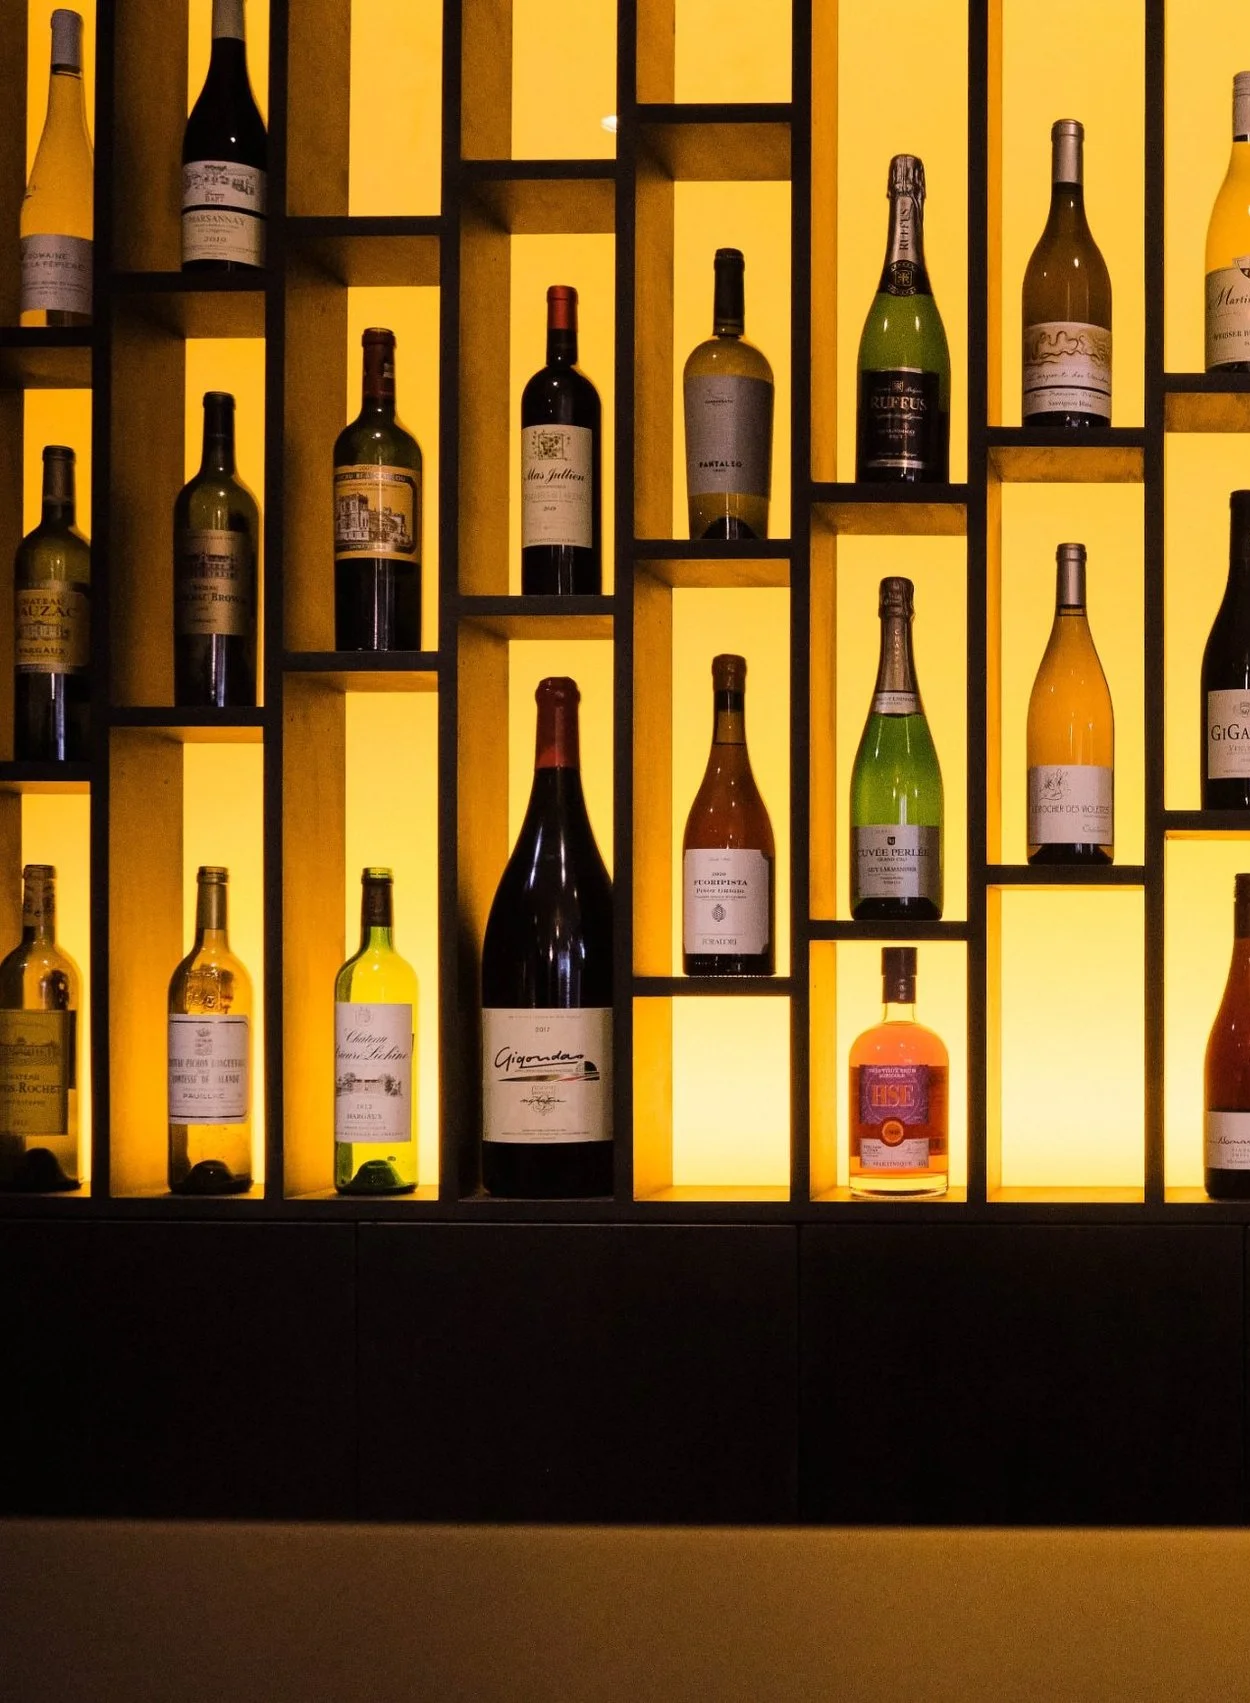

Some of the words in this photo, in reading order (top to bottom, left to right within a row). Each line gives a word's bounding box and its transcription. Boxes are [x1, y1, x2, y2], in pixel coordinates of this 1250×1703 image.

[870, 395, 927, 411] RUFFUS
[692, 878, 748, 887] FUORIPISTA
[870, 1083, 915, 1109] HSE
